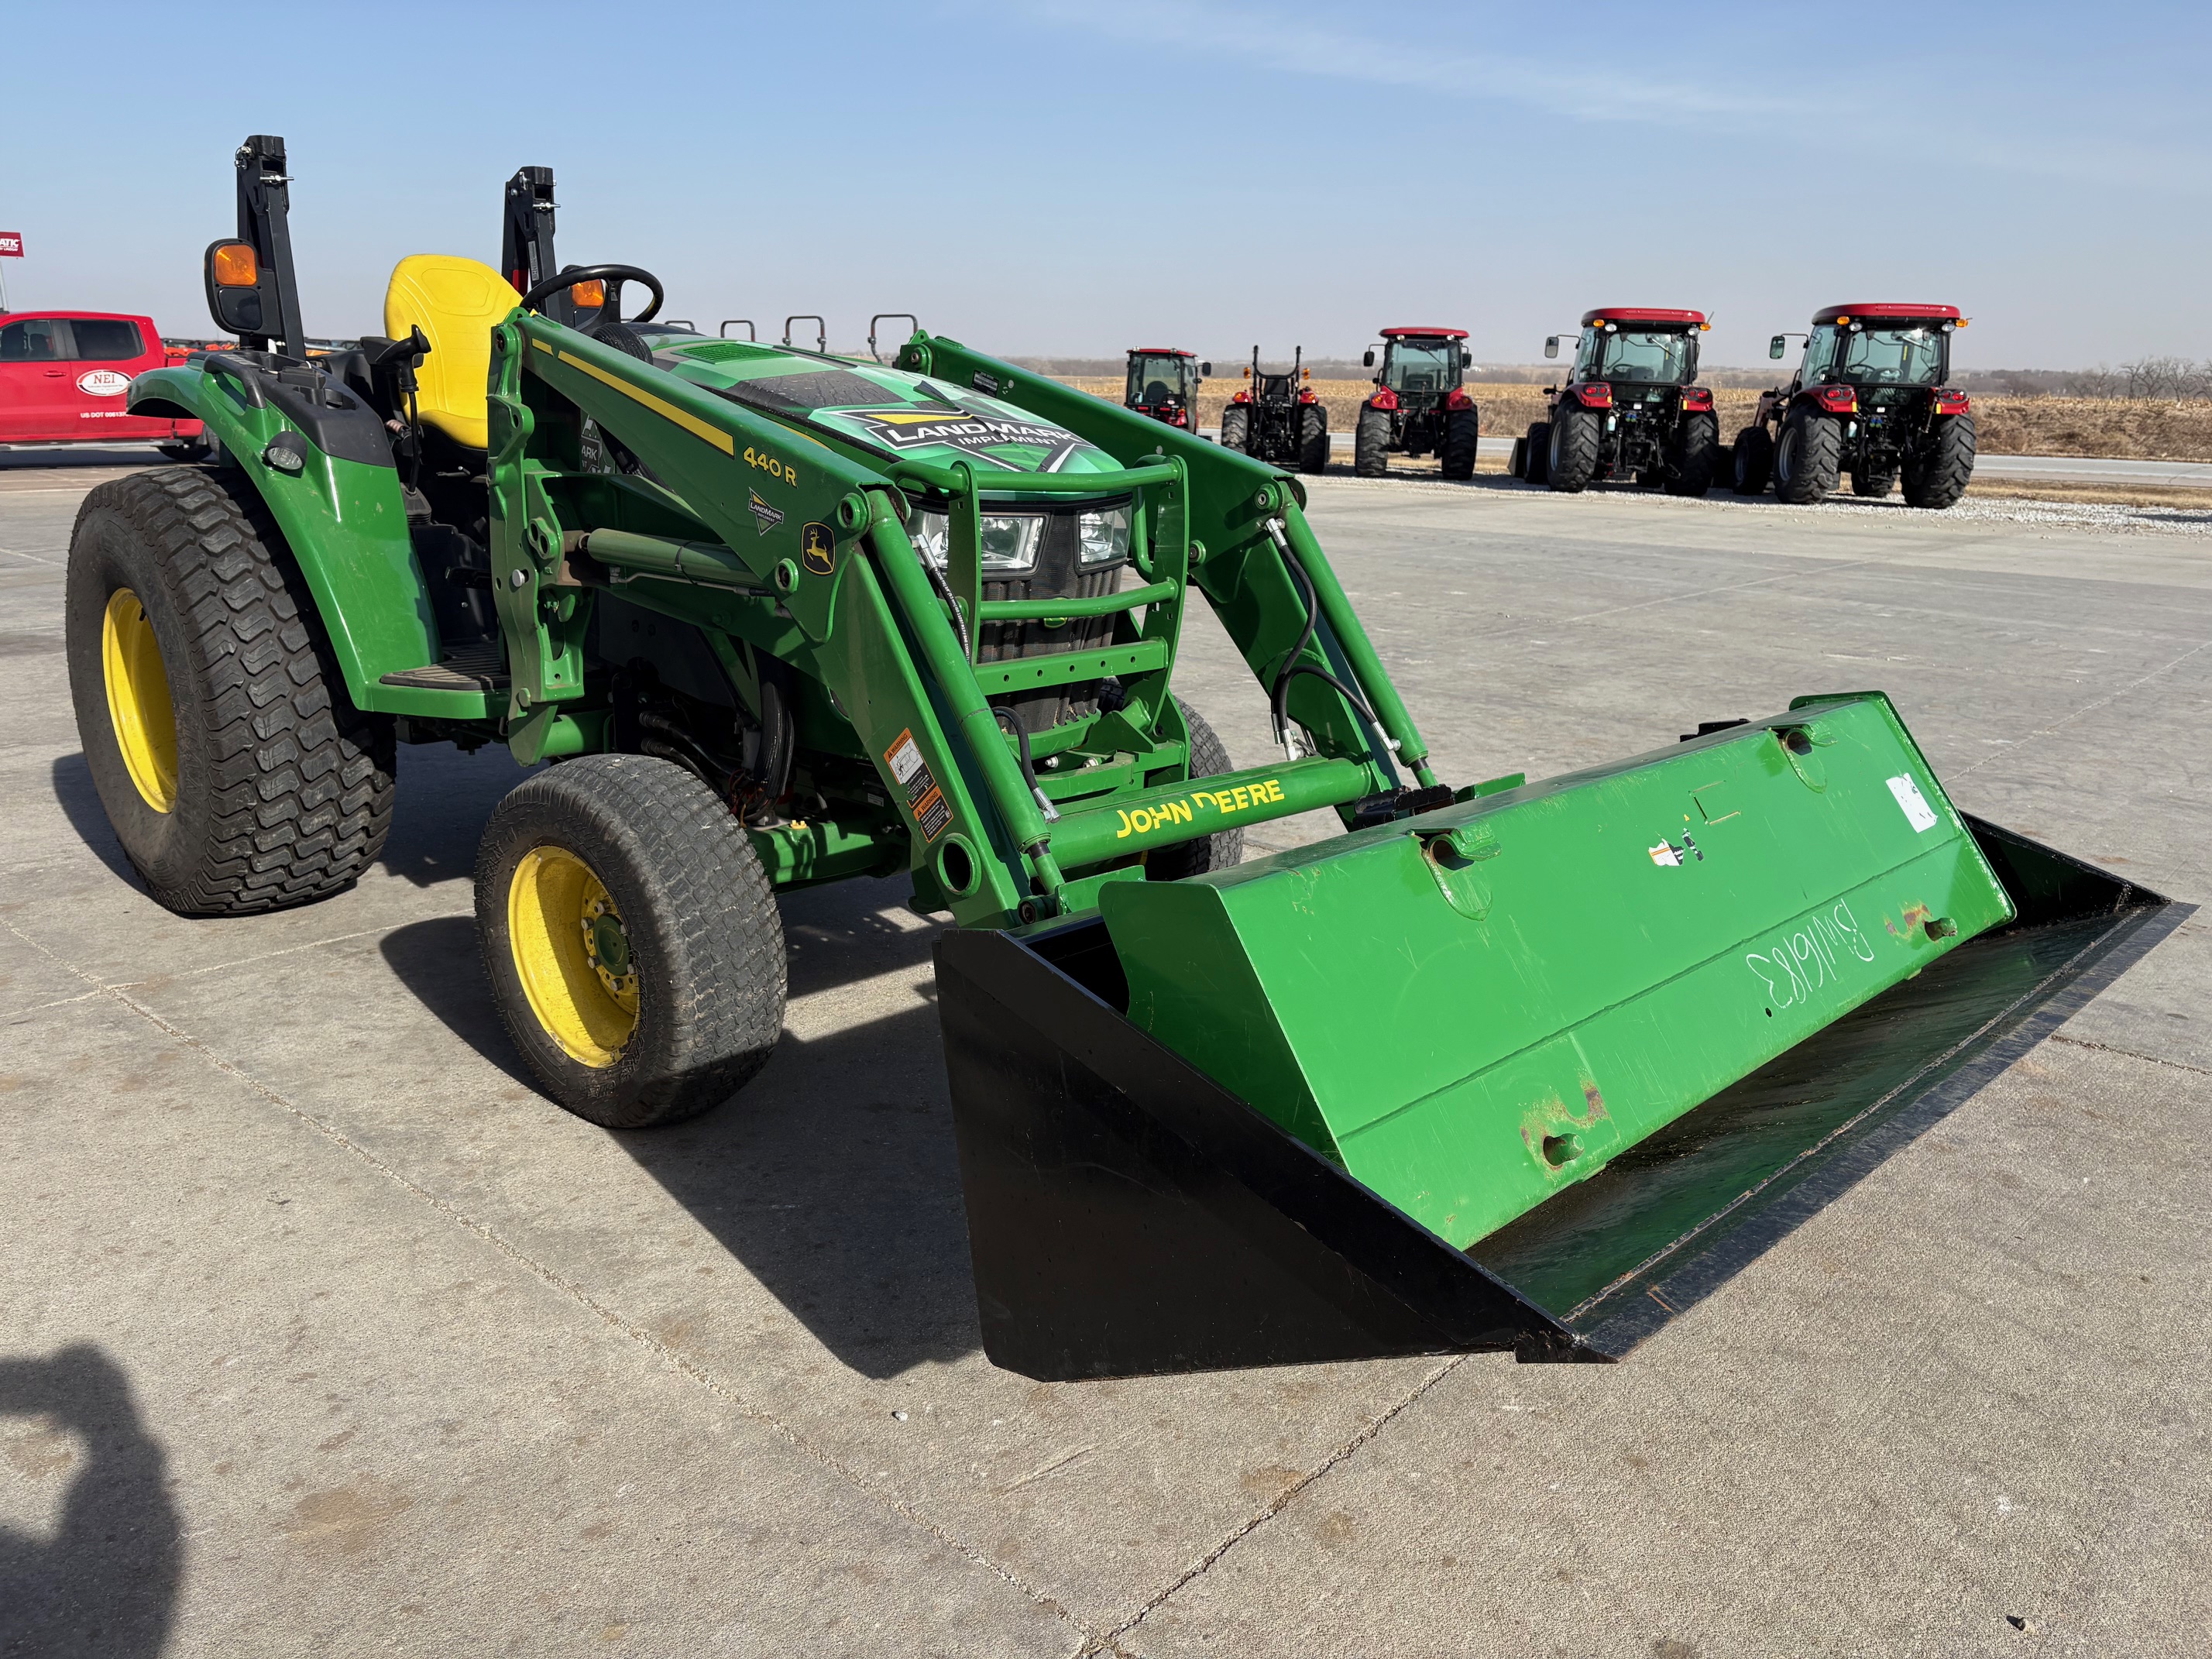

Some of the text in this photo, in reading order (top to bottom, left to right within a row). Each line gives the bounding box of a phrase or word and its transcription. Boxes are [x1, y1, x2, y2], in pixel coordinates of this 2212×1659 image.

[94, 374, 115, 383] NEI
[887, 421, 1082, 443] LANDMARK
[744, 446, 797, 487] 440 R
[750, 501, 782, 521] LANDMARK
[891, 733, 908, 754] WARNING
[920, 791, 939, 811] WARNING
[1116, 799, 1193, 839] JOHN
[1746, 898, 1875, 1009] BW16183
